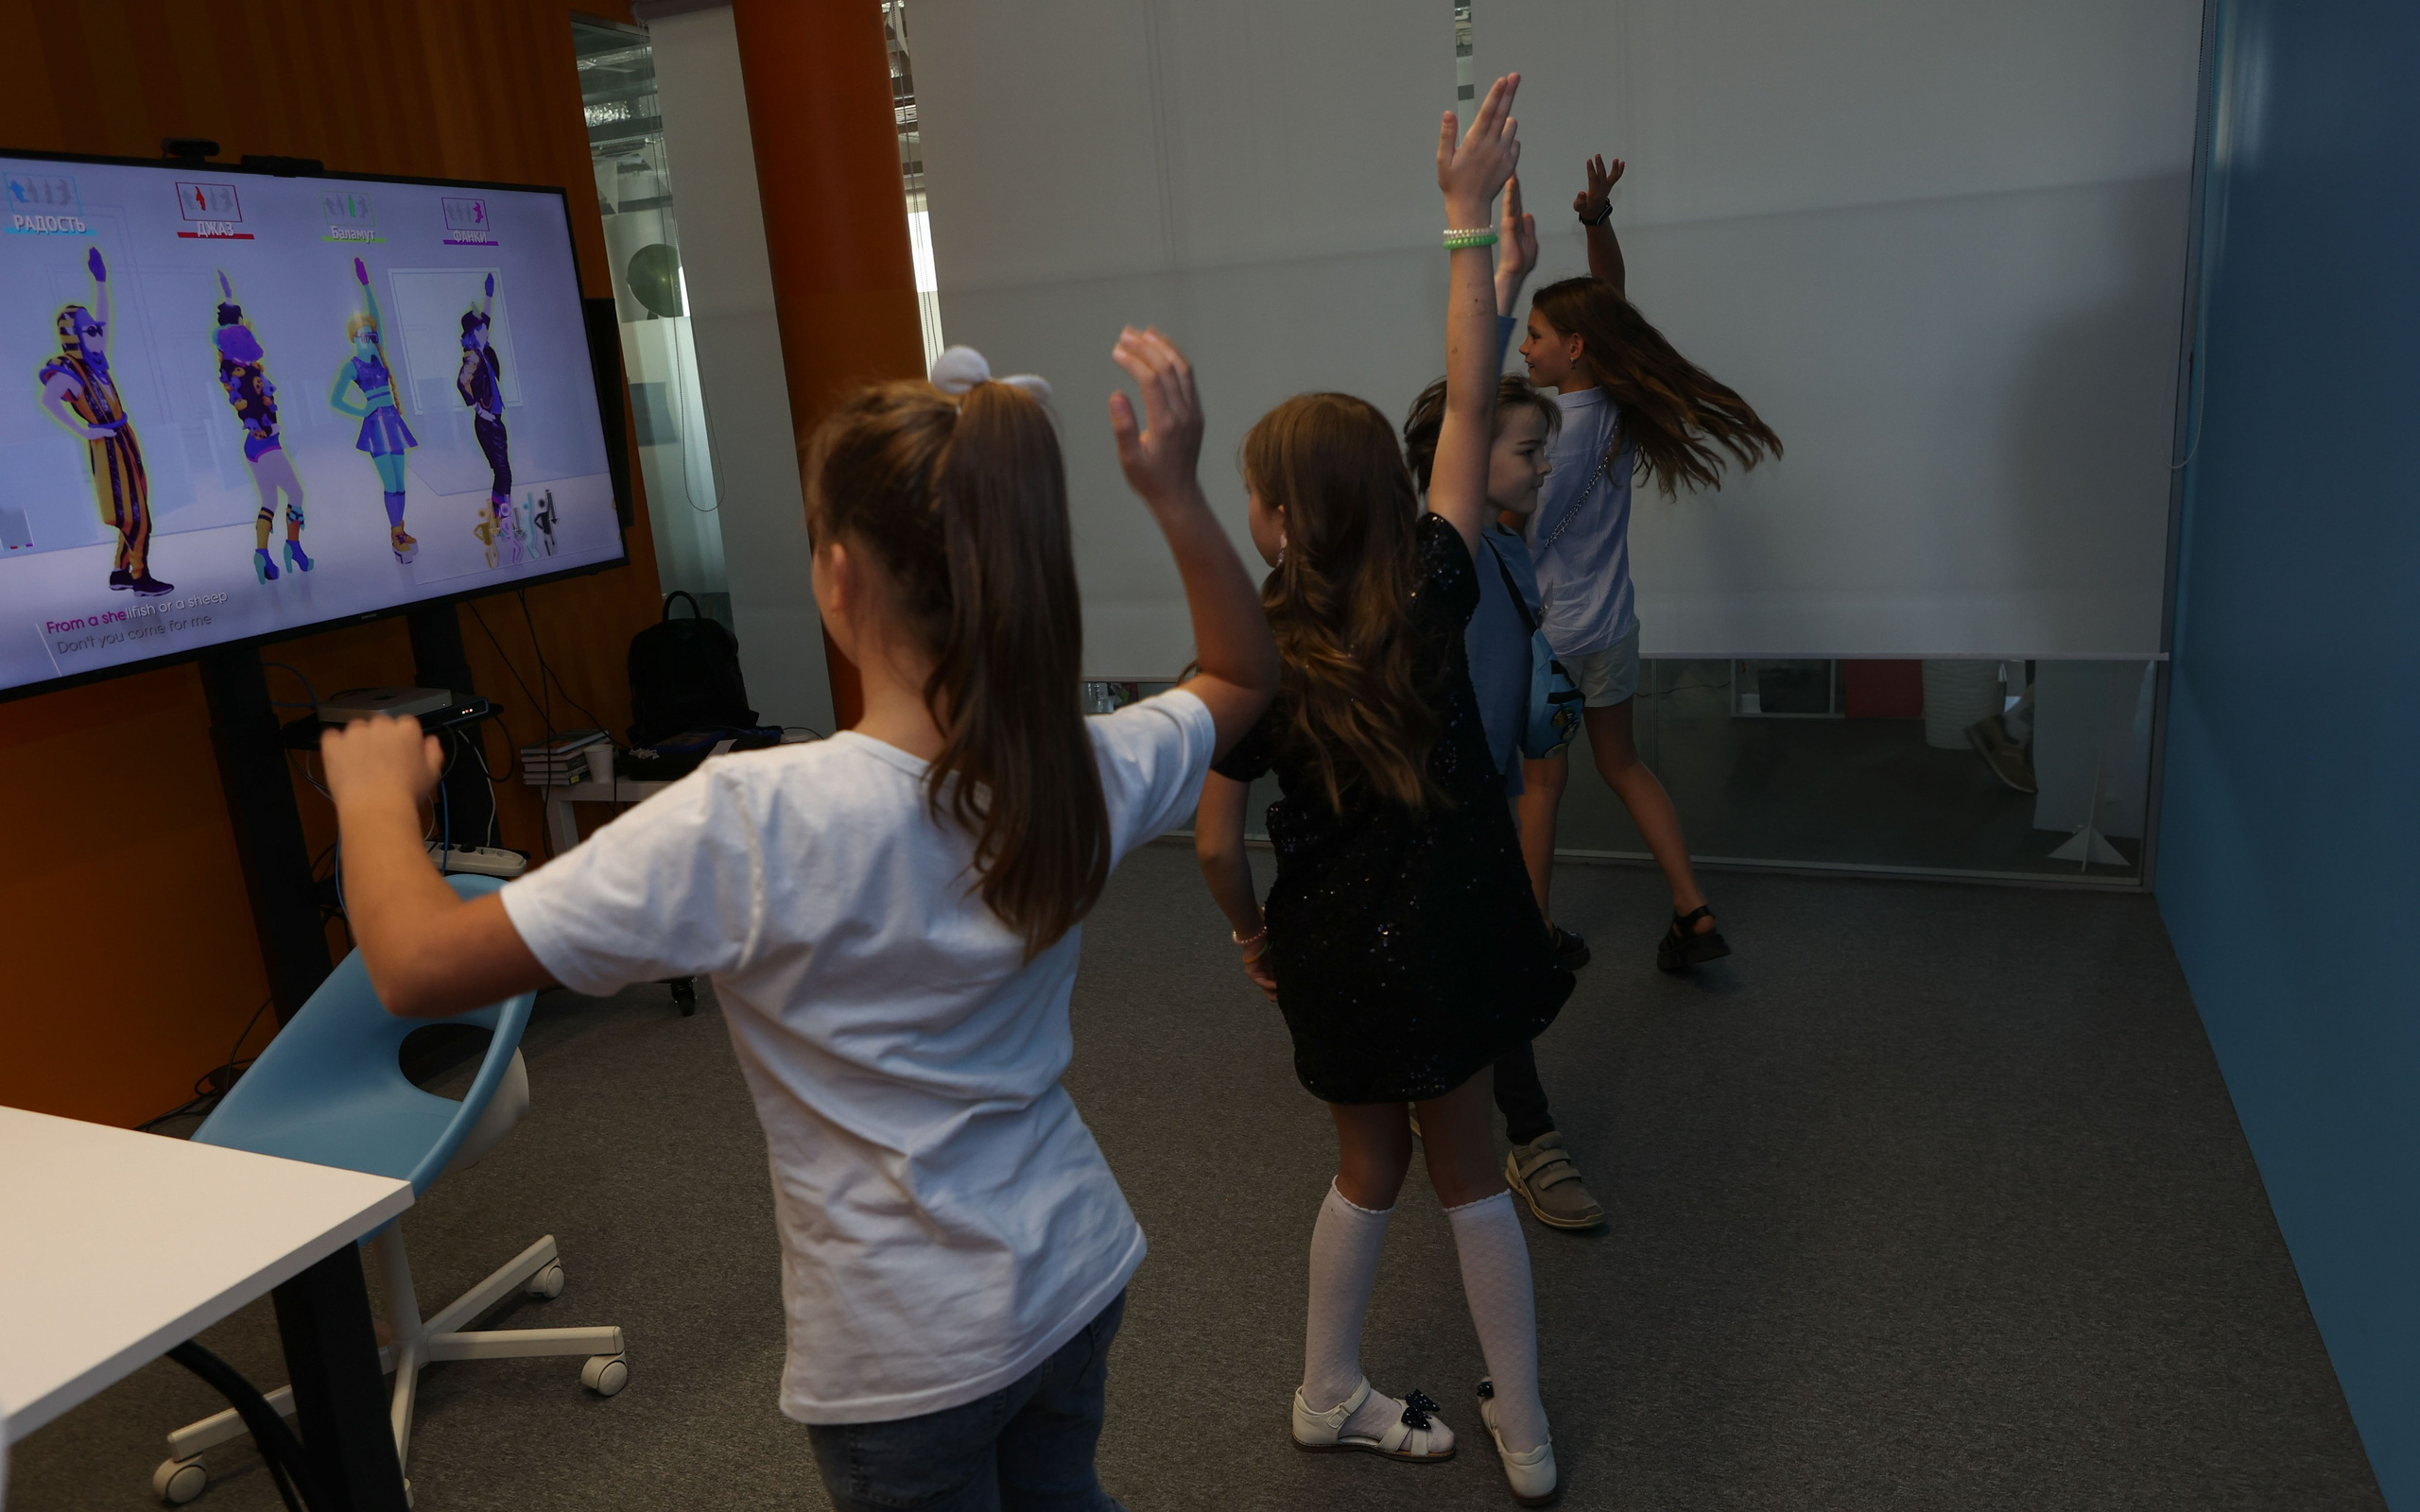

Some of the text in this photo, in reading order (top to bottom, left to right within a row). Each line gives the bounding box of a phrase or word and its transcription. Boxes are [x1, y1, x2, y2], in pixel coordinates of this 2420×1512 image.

[12, 215, 87, 235] РАДОСТЬ
[198, 220, 234, 238] ДЖАЗ
[330, 225, 376, 245] Баламут
[453, 230, 489, 244] ФАНКИ
[45, 591, 229, 635] From a shellfish or a sheep
[57, 614, 213, 655] Don't you come for me
